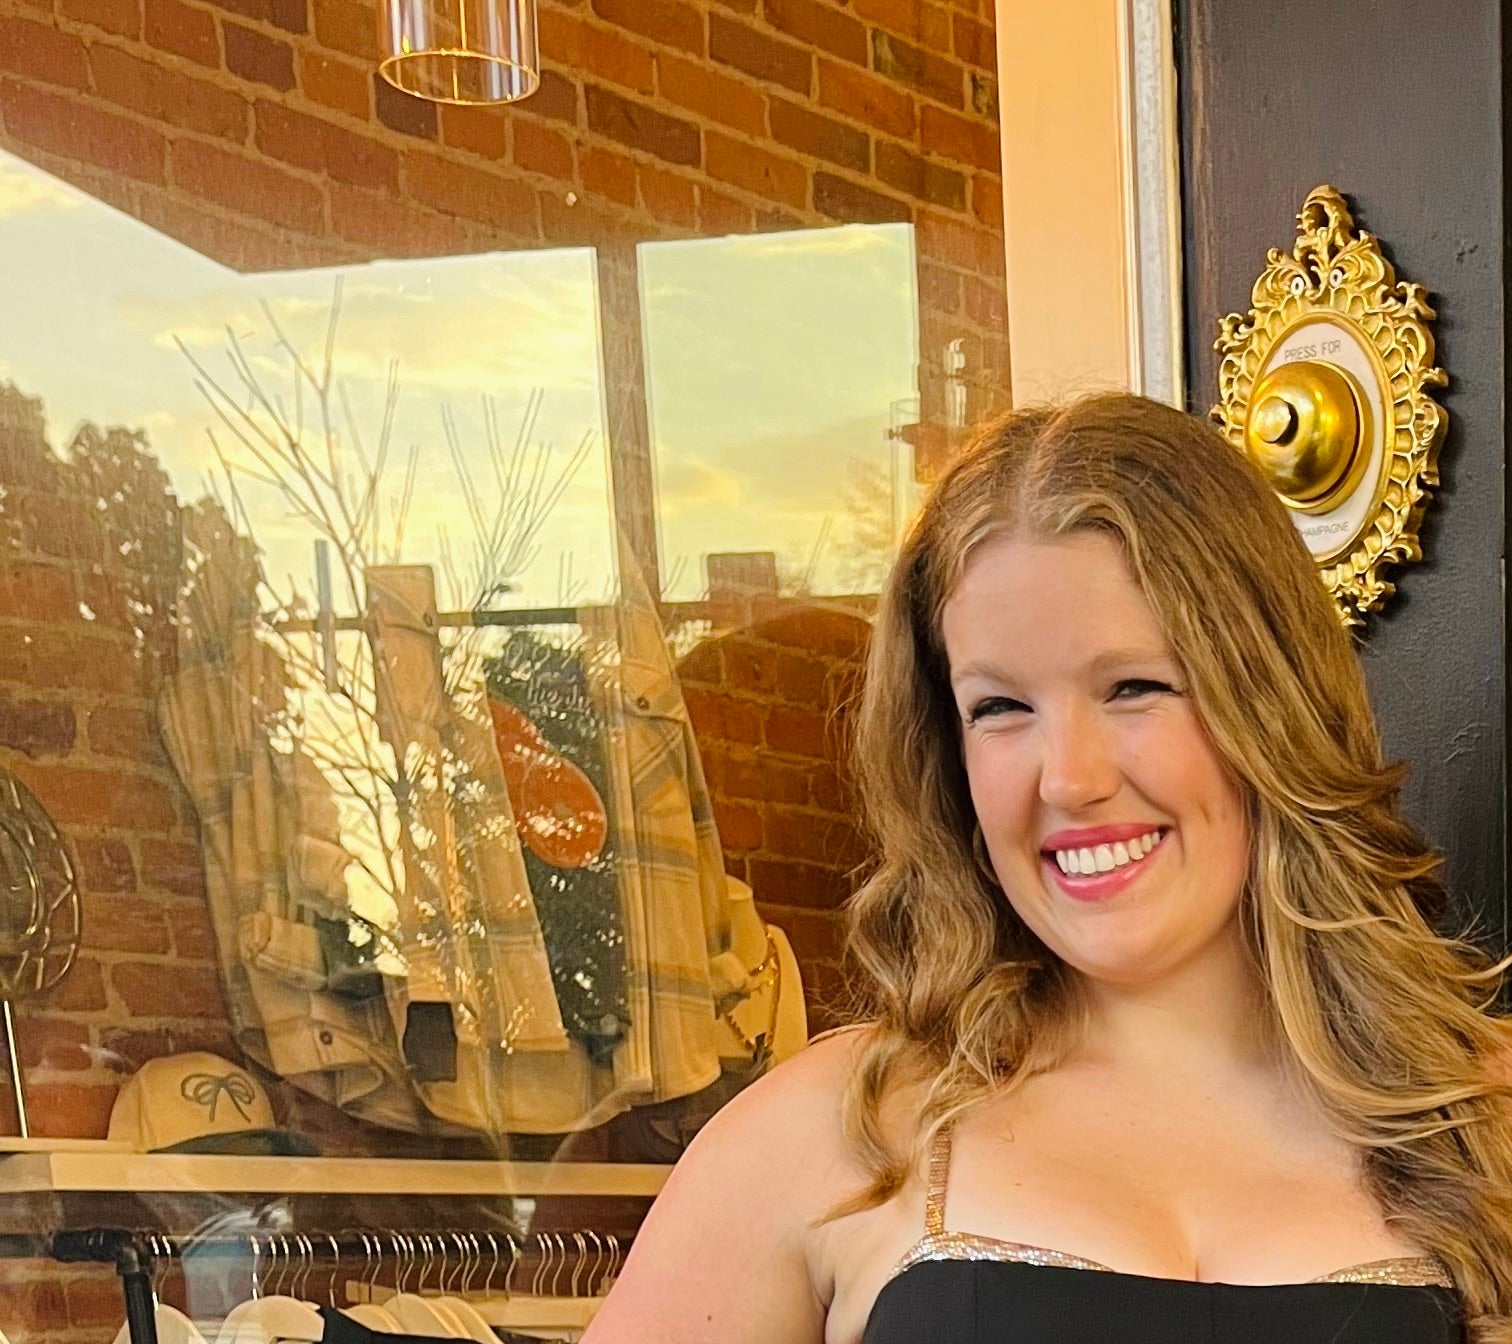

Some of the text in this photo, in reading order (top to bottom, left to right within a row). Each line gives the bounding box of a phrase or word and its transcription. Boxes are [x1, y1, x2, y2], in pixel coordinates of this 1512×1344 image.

[1284, 339, 1342, 361] PRESS FOR
[1300, 521, 1350, 536] HAMPAGNE
